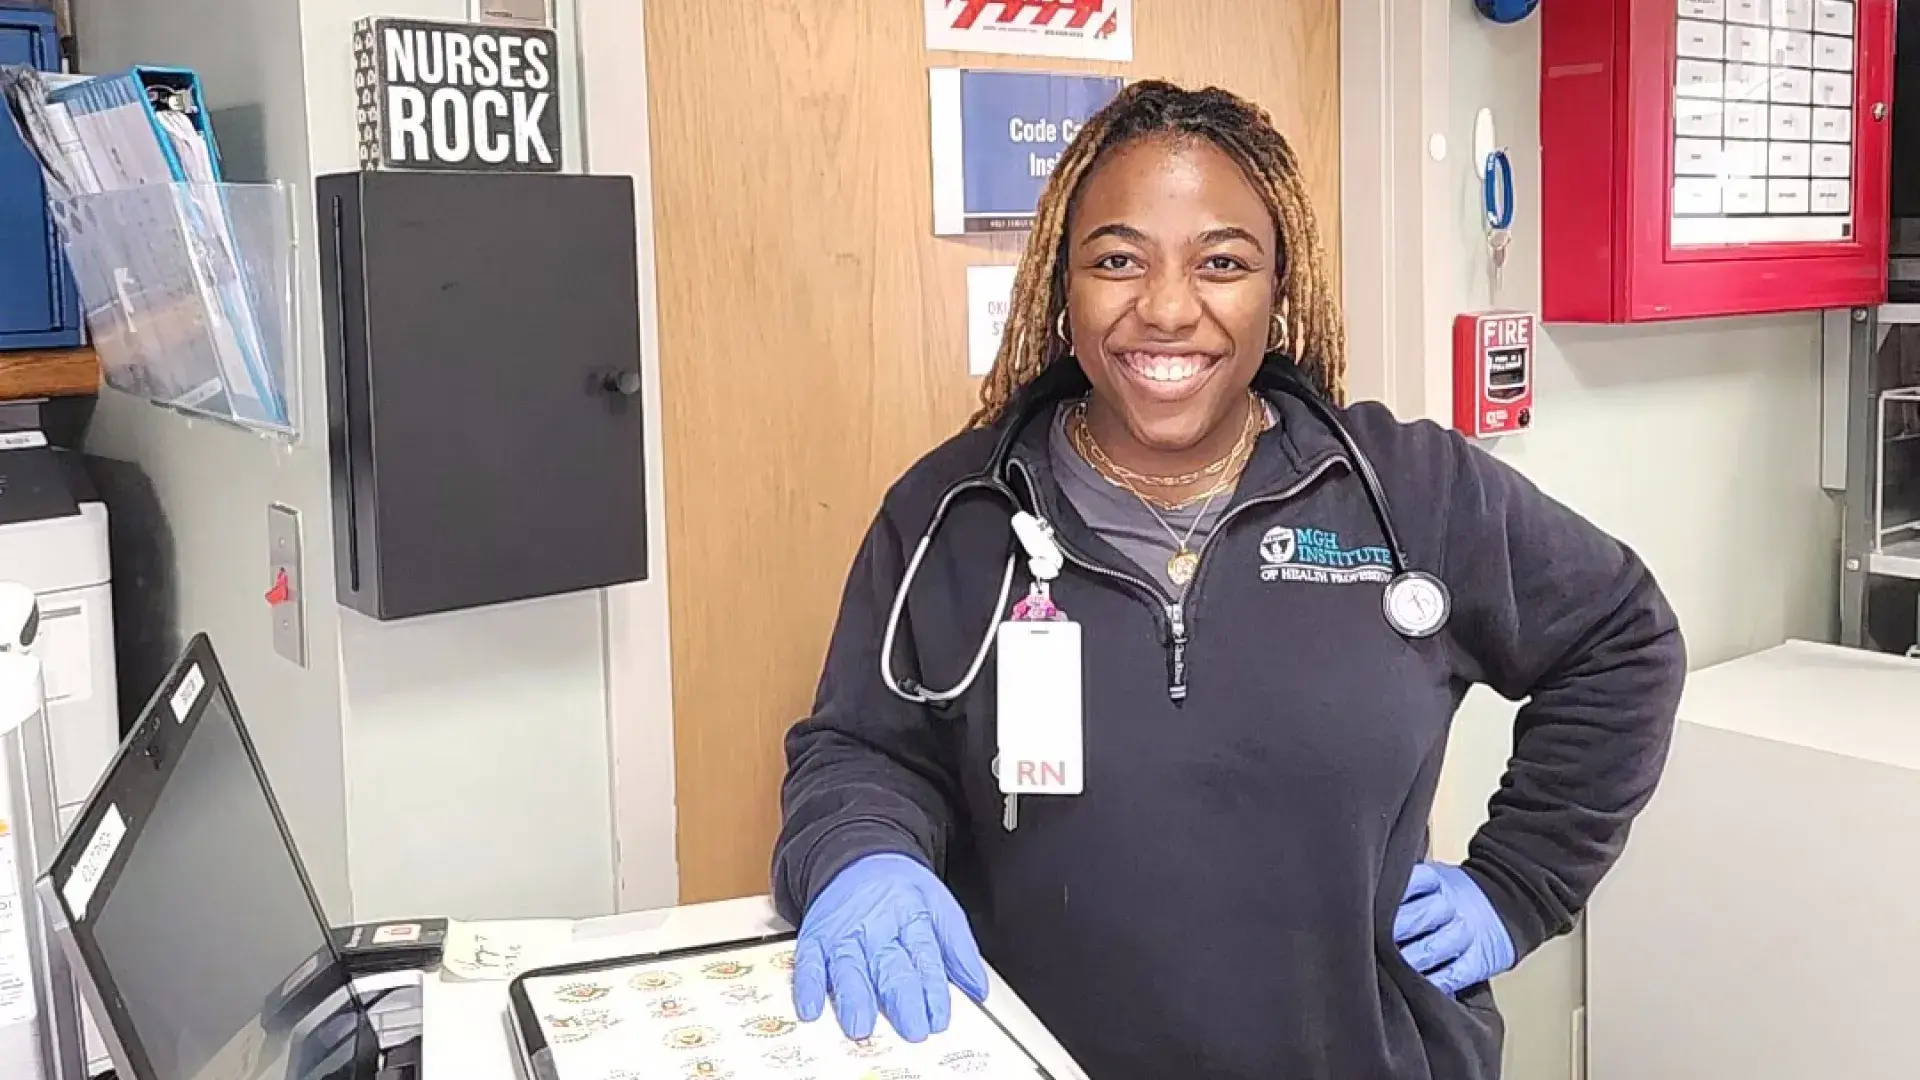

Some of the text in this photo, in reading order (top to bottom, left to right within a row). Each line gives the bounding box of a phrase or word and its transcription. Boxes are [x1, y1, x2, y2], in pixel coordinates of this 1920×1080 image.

[383, 27, 550, 90] NURSES
[387, 85, 554, 164] ROCK
[1009, 117, 1057, 143] Code
[1483, 319, 1530, 346] FIRE
[1296, 528, 1338, 549] MGH
[1298, 545, 1393, 567] INSTITUTE
[1261, 569, 1279, 581] OF
[1281, 568, 1329, 583] HEALTH
[1016, 760, 1066, 786] RN
